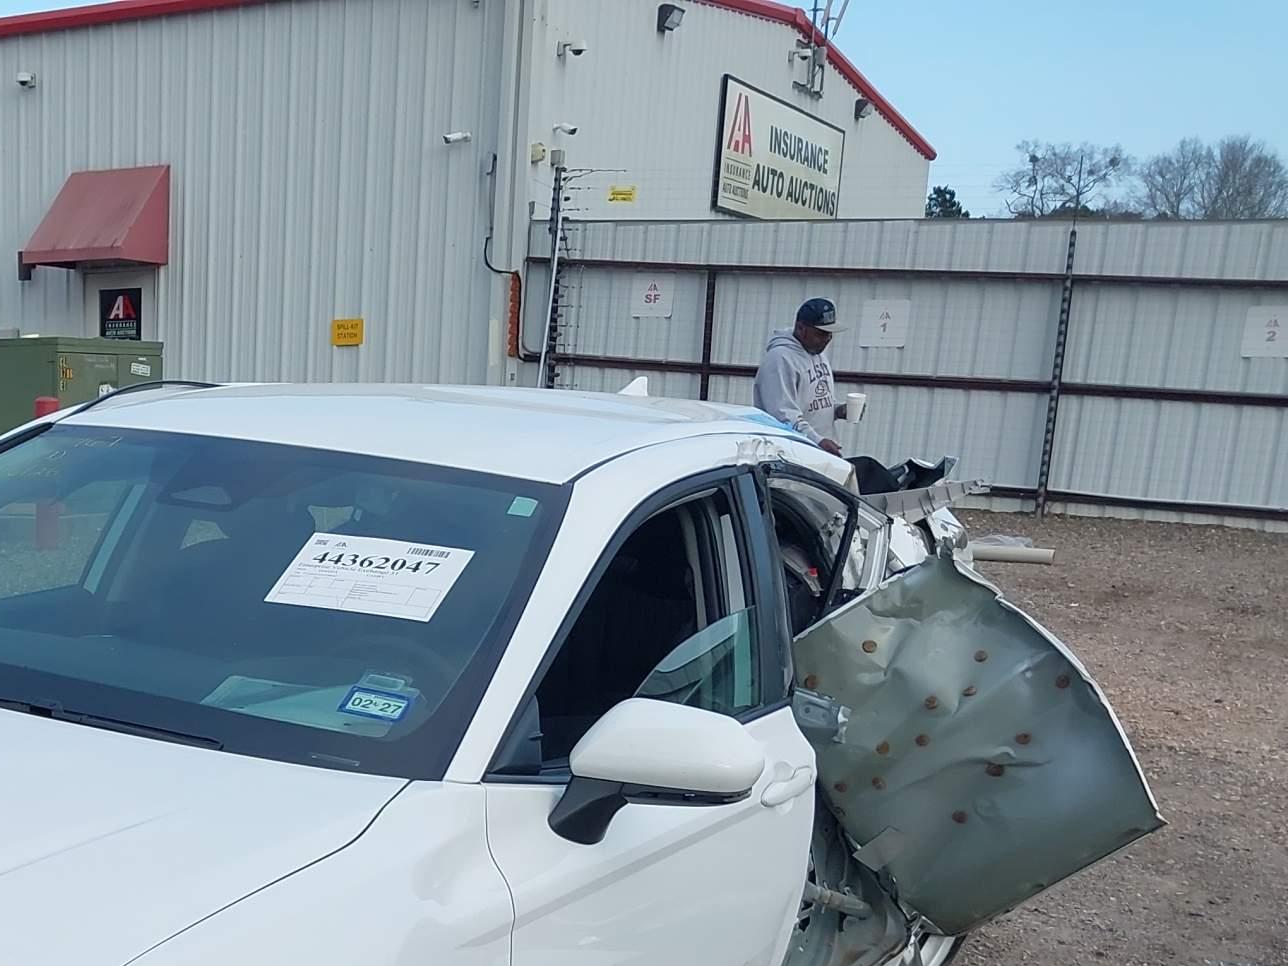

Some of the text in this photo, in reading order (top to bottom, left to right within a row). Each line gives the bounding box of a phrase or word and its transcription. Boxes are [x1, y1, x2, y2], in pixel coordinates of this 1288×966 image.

[769, 124, 830, 175] INSURANCE
[752, 162, 836, 217] AUTO AUCTIONS
[644, 293, 661, 304] SF
[880, 322, 887, 333] 1
[1265, 330, 1277, 342] 2
[312, 551, 441, 575] 44362047
[352, 697, 402, 714] 02 27
